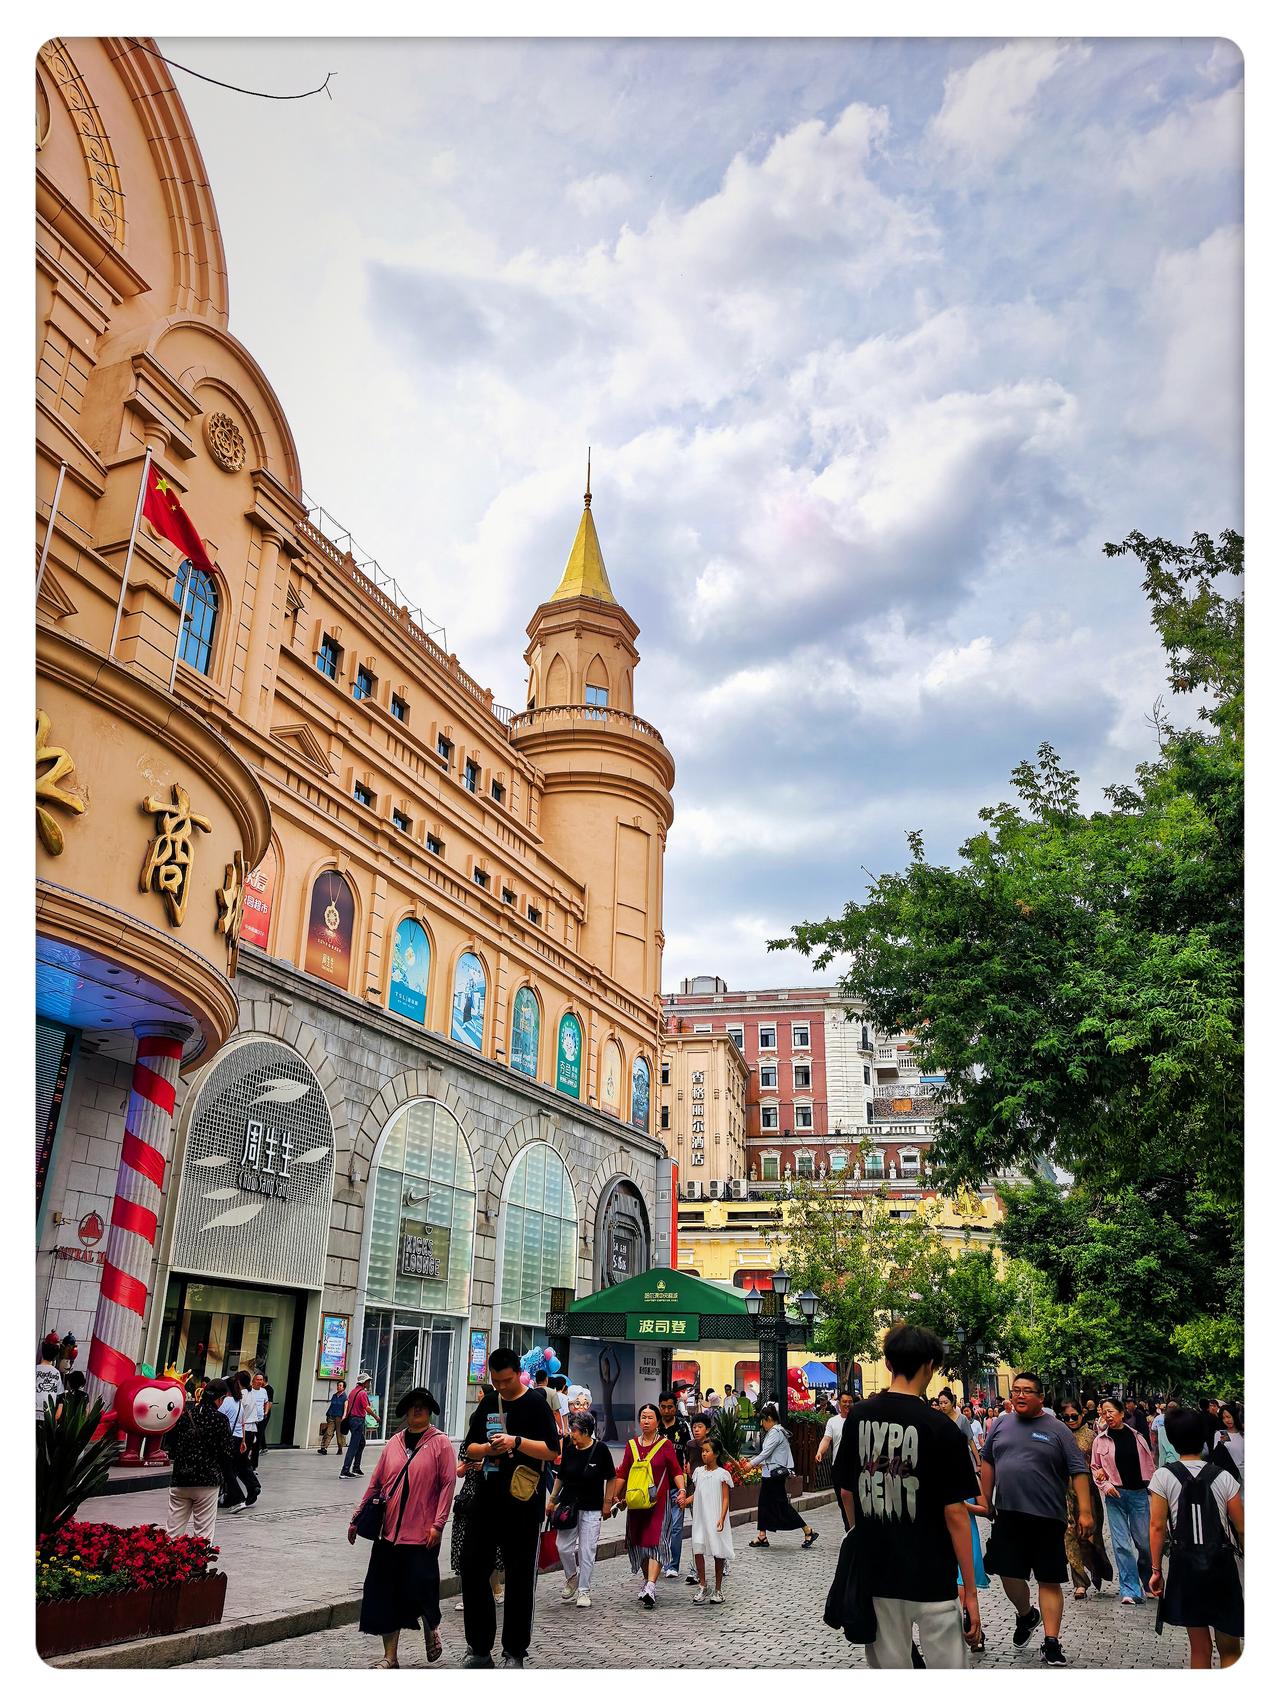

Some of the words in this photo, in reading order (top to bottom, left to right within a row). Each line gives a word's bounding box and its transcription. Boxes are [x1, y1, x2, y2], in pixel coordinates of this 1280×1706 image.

[241, 1120, 293, 1177] 周生生
[404, 1234, 433, 1257] KICKS
[404, 1253, 440, 1276] LOUNGE
[639, 1319, 687, 1334] 波司登
[859, 1420, 919, 1469] HYPA
